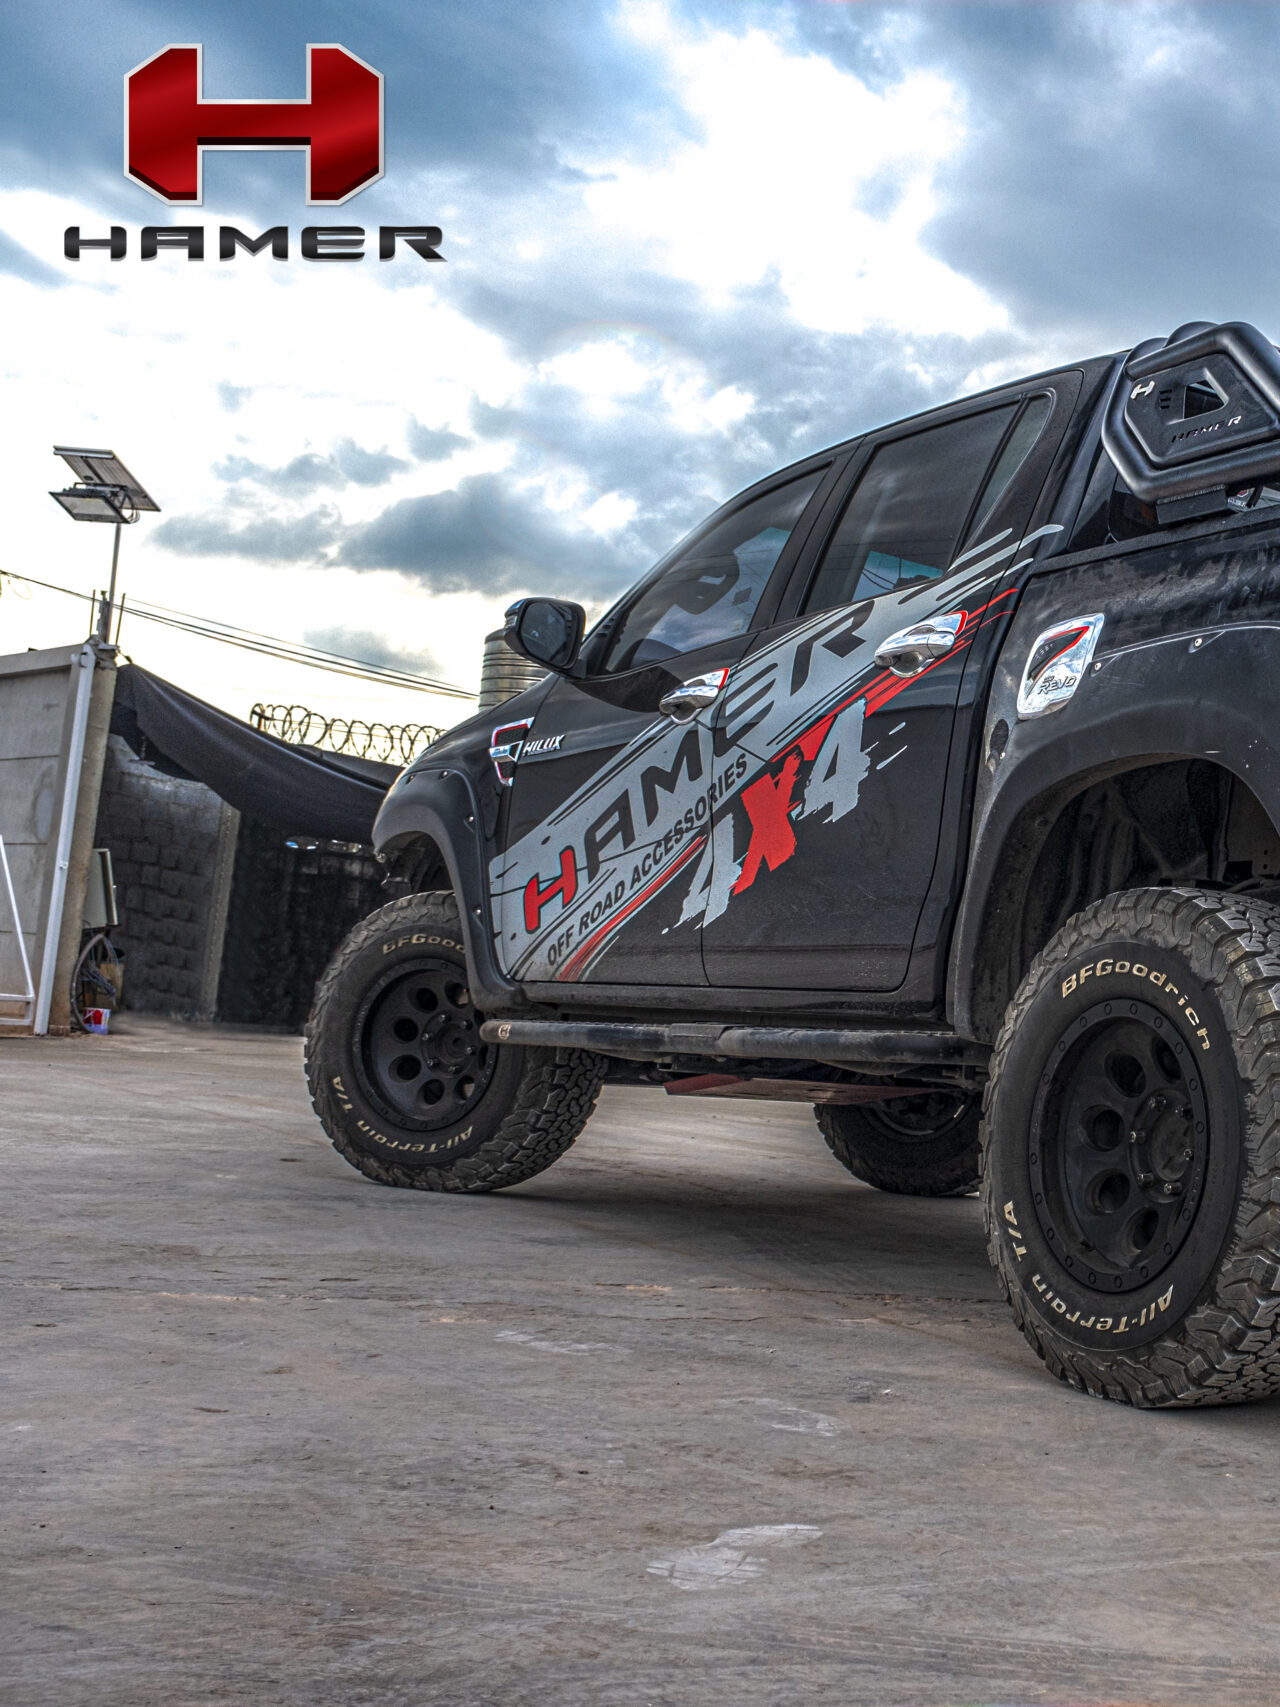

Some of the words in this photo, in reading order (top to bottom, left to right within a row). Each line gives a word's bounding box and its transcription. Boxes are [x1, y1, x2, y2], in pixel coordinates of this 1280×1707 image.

[1037, 675, 1077, 694] REVO
[522, 733, 567, 757] HILUX
[523, 599, 875, 934] HAMER
[547, 924, 575, 967] OFF
[578, 879, 625, 936] ROAD
[629, 752, 748, 890] ACCESSORIES
[1060, 957, 1211, 1051] BFGoodrich
[332, 1075, 354, 1113] T/A
[357, 1125, 473, 1153] All-Terrain
[1002, 1200, 1026, 1262] T/A
[1031, 1273, 1174, 1334] All-Terrain
